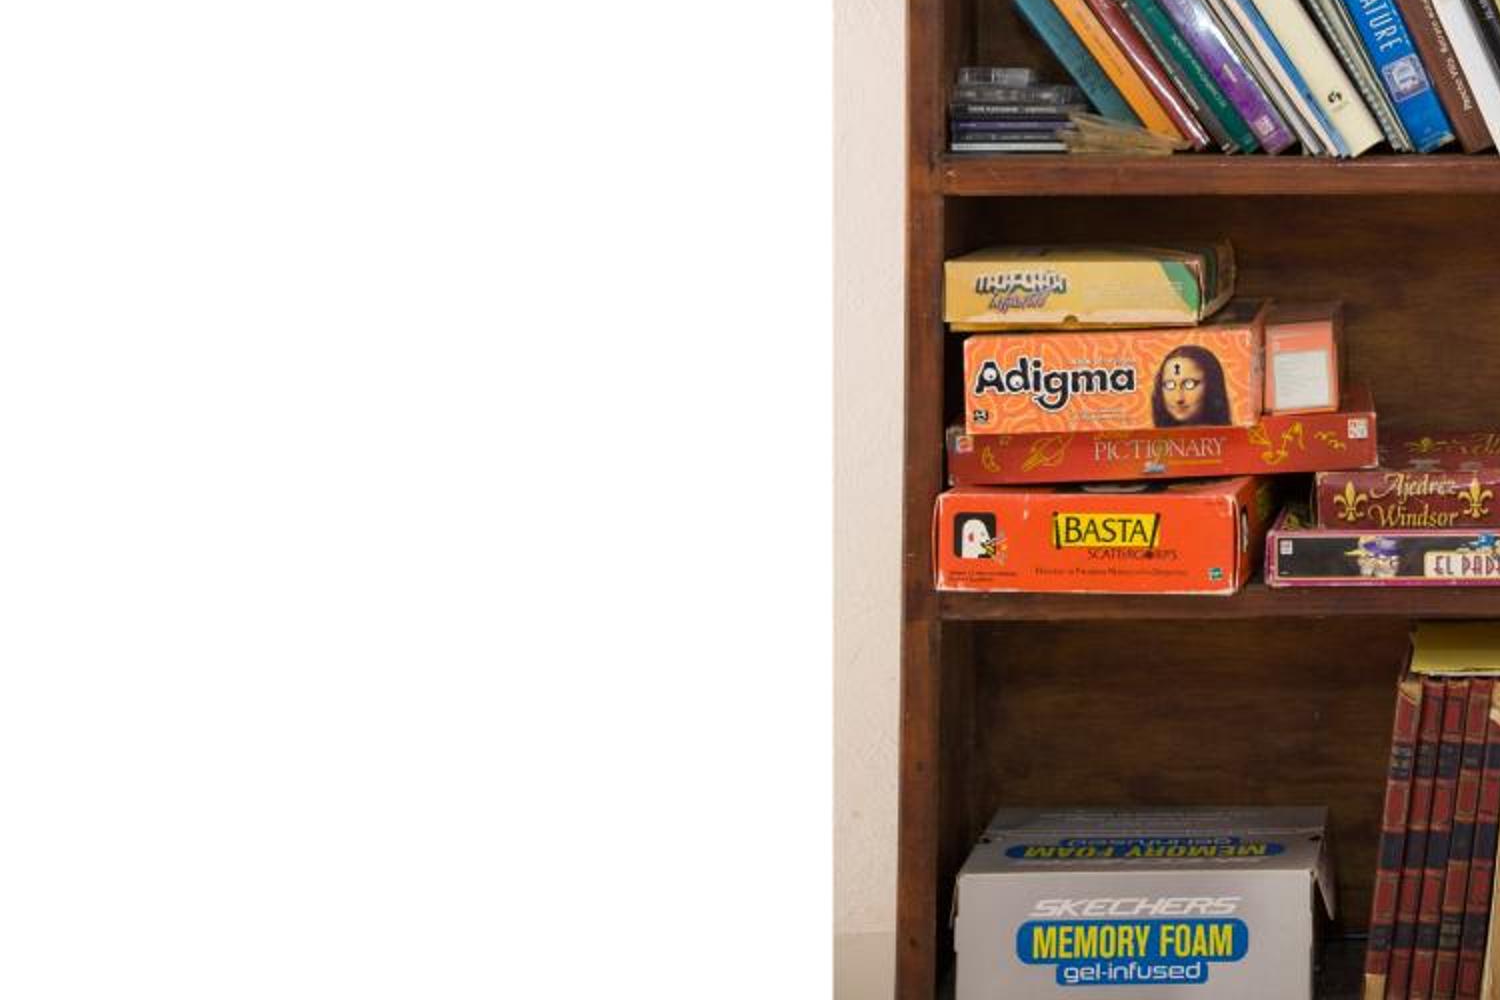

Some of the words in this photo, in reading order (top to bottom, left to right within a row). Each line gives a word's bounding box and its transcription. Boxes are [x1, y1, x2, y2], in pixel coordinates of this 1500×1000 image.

[975, 356, 1137, 410] Adigma
[1093, 438, 1228, 461] PICTIONARY
[1369, 473, 1458, 502] Ajedrez
[1368, 503, 1458, 528] Windsor
[1434, 557, 1454, 576] EL
[1025, 845, 1114, 858] FOAM
[1123, 843, 1266, 858] MEMORY
[1030, 896, 1241, 917] SKECHERS
[1032, 925, 1150, 959] MEMORY
[1160, 924, 1233, 956] FOAM
[1063, 963, 1202, 982] gel-infused
